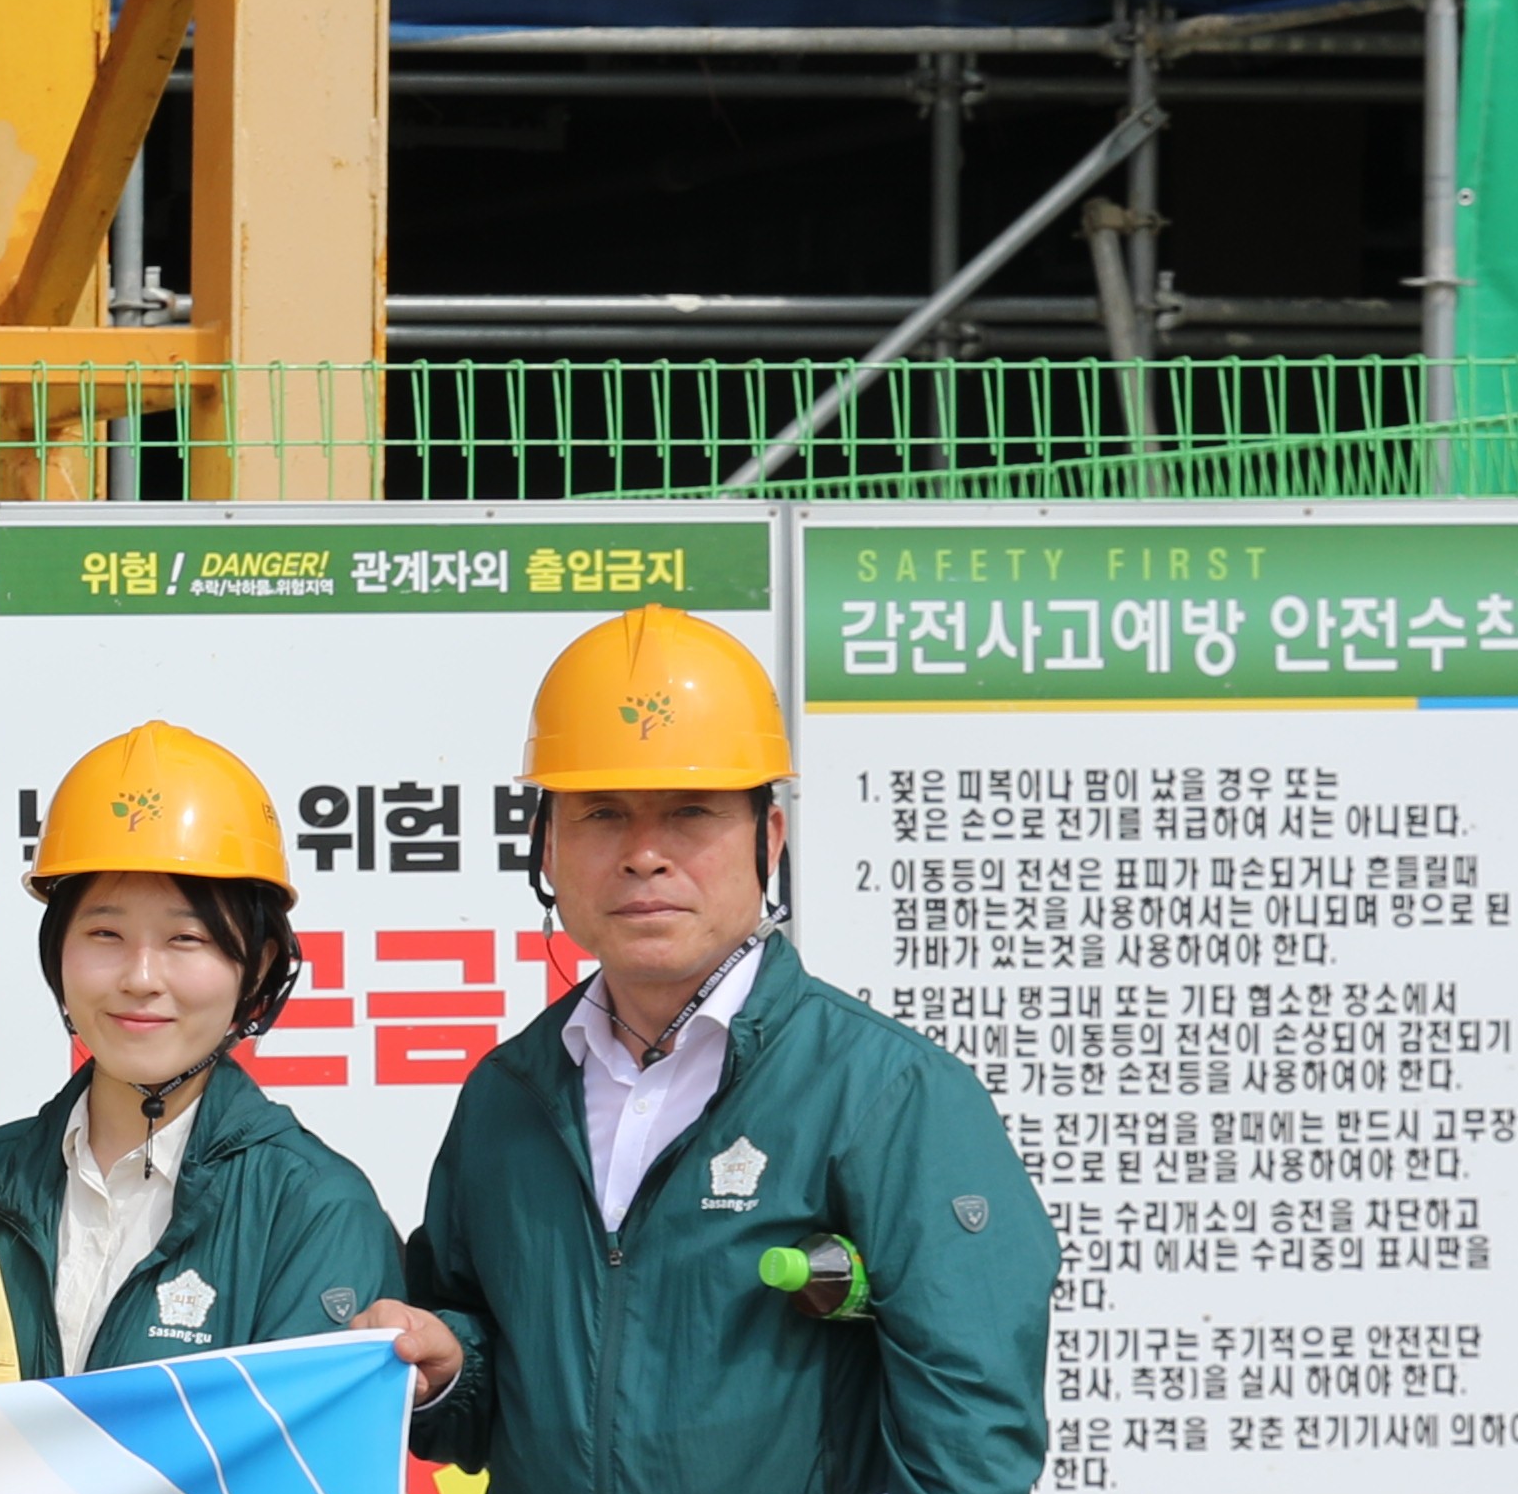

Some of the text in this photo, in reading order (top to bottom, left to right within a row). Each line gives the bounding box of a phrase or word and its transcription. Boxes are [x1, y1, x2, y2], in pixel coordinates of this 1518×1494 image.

[200, 550, 330, 578] DANGER!
[350, 549, 509, 594] 관계자외
[525, 548, 687, 594] 출입금지
[857, 546, 1268, 583] SAFETY FIRST
[842, 597, 1245, 677] 감전사고예방
[858, 771, 879, 802] 1.
[890, 769, 945, 804] 젖은
[958, 769, 1073, 804] 피복이나
[1085, 768, 1138, 803] 땀이
[1218, 767, 1271, 803] 경우
[1285, 767, 1338, 801] 또는
[297, 781, 461, 873] 위험
[893, 804, 1466, 842] 젖은 손으로 전기를 취급하여 서는 아니된다.
[857, 860, 880, 892] 2.
[891, 858, 1004, 894] 이동등의
[1017, 857, 1101, 893] 전선은
[1115, 857, 1199, 891] 표피가
[1367, 855, 1477, 890] 흔들릴때
[893, 896, 1067, 932] 점멸하는것을
[1080, 895, 1252, 931] 사용하여서는
[1265, 894, 1377, 928] 아니되며
[1487, 893, 1509, 926] 된
[895, 932, 1335, 970] 카바가 있는것을 사용하여야 한다.
[895, 986, 1007, 1021] 보일러나
[1116, 985, 1168, 1019] 또는
[1182, 984, 1236, 1018] 기타
[1248, 983, 1332, 1018] 협소한
[1344, 982, 1456, 1018] 장소에서
[1050, 1020, 1510, 1059] 이동등의 전선이 손상되어 감전되기
[1022, 1062, 1106, 1097] 가능한
[1118, 1060, 1230, 1095] 손전등을
[1243, 1059, 1387, 1095] 사용하여야
[1398, 1058, 1460, 1092] 한다.
[1055, 1111, 1197, 1147] 전기작업을
[1337, 1109, 1419, 1144] 반드시
[1434, 1108, 1517, 1143] 고무장
[1118, 1147, 1470, 1184] 된 신발을 사용하여야 한다.
[1116, 1198, 1479, 1235] 수리개소의 송전을 차단하고
[1155, 1235, 1489, 1272] 에서는 수리중의 표시판을
[148, 1326, 212, 1344] Sasang-gu
[1056, 1325, 1481, 1363] 전기기구는 주기적으로 안전진단
[1240, 1365, 1293, 1399] 실시
[1307, 1364, 1391, 1398] 하여야
[1403, 1363, 1467, 1397] 한다.
[1124, 1413, 1518, 1451] 자격을 갖춘 전기기사에 의하
[1053, 1456, 1115, 1491] 한다.
